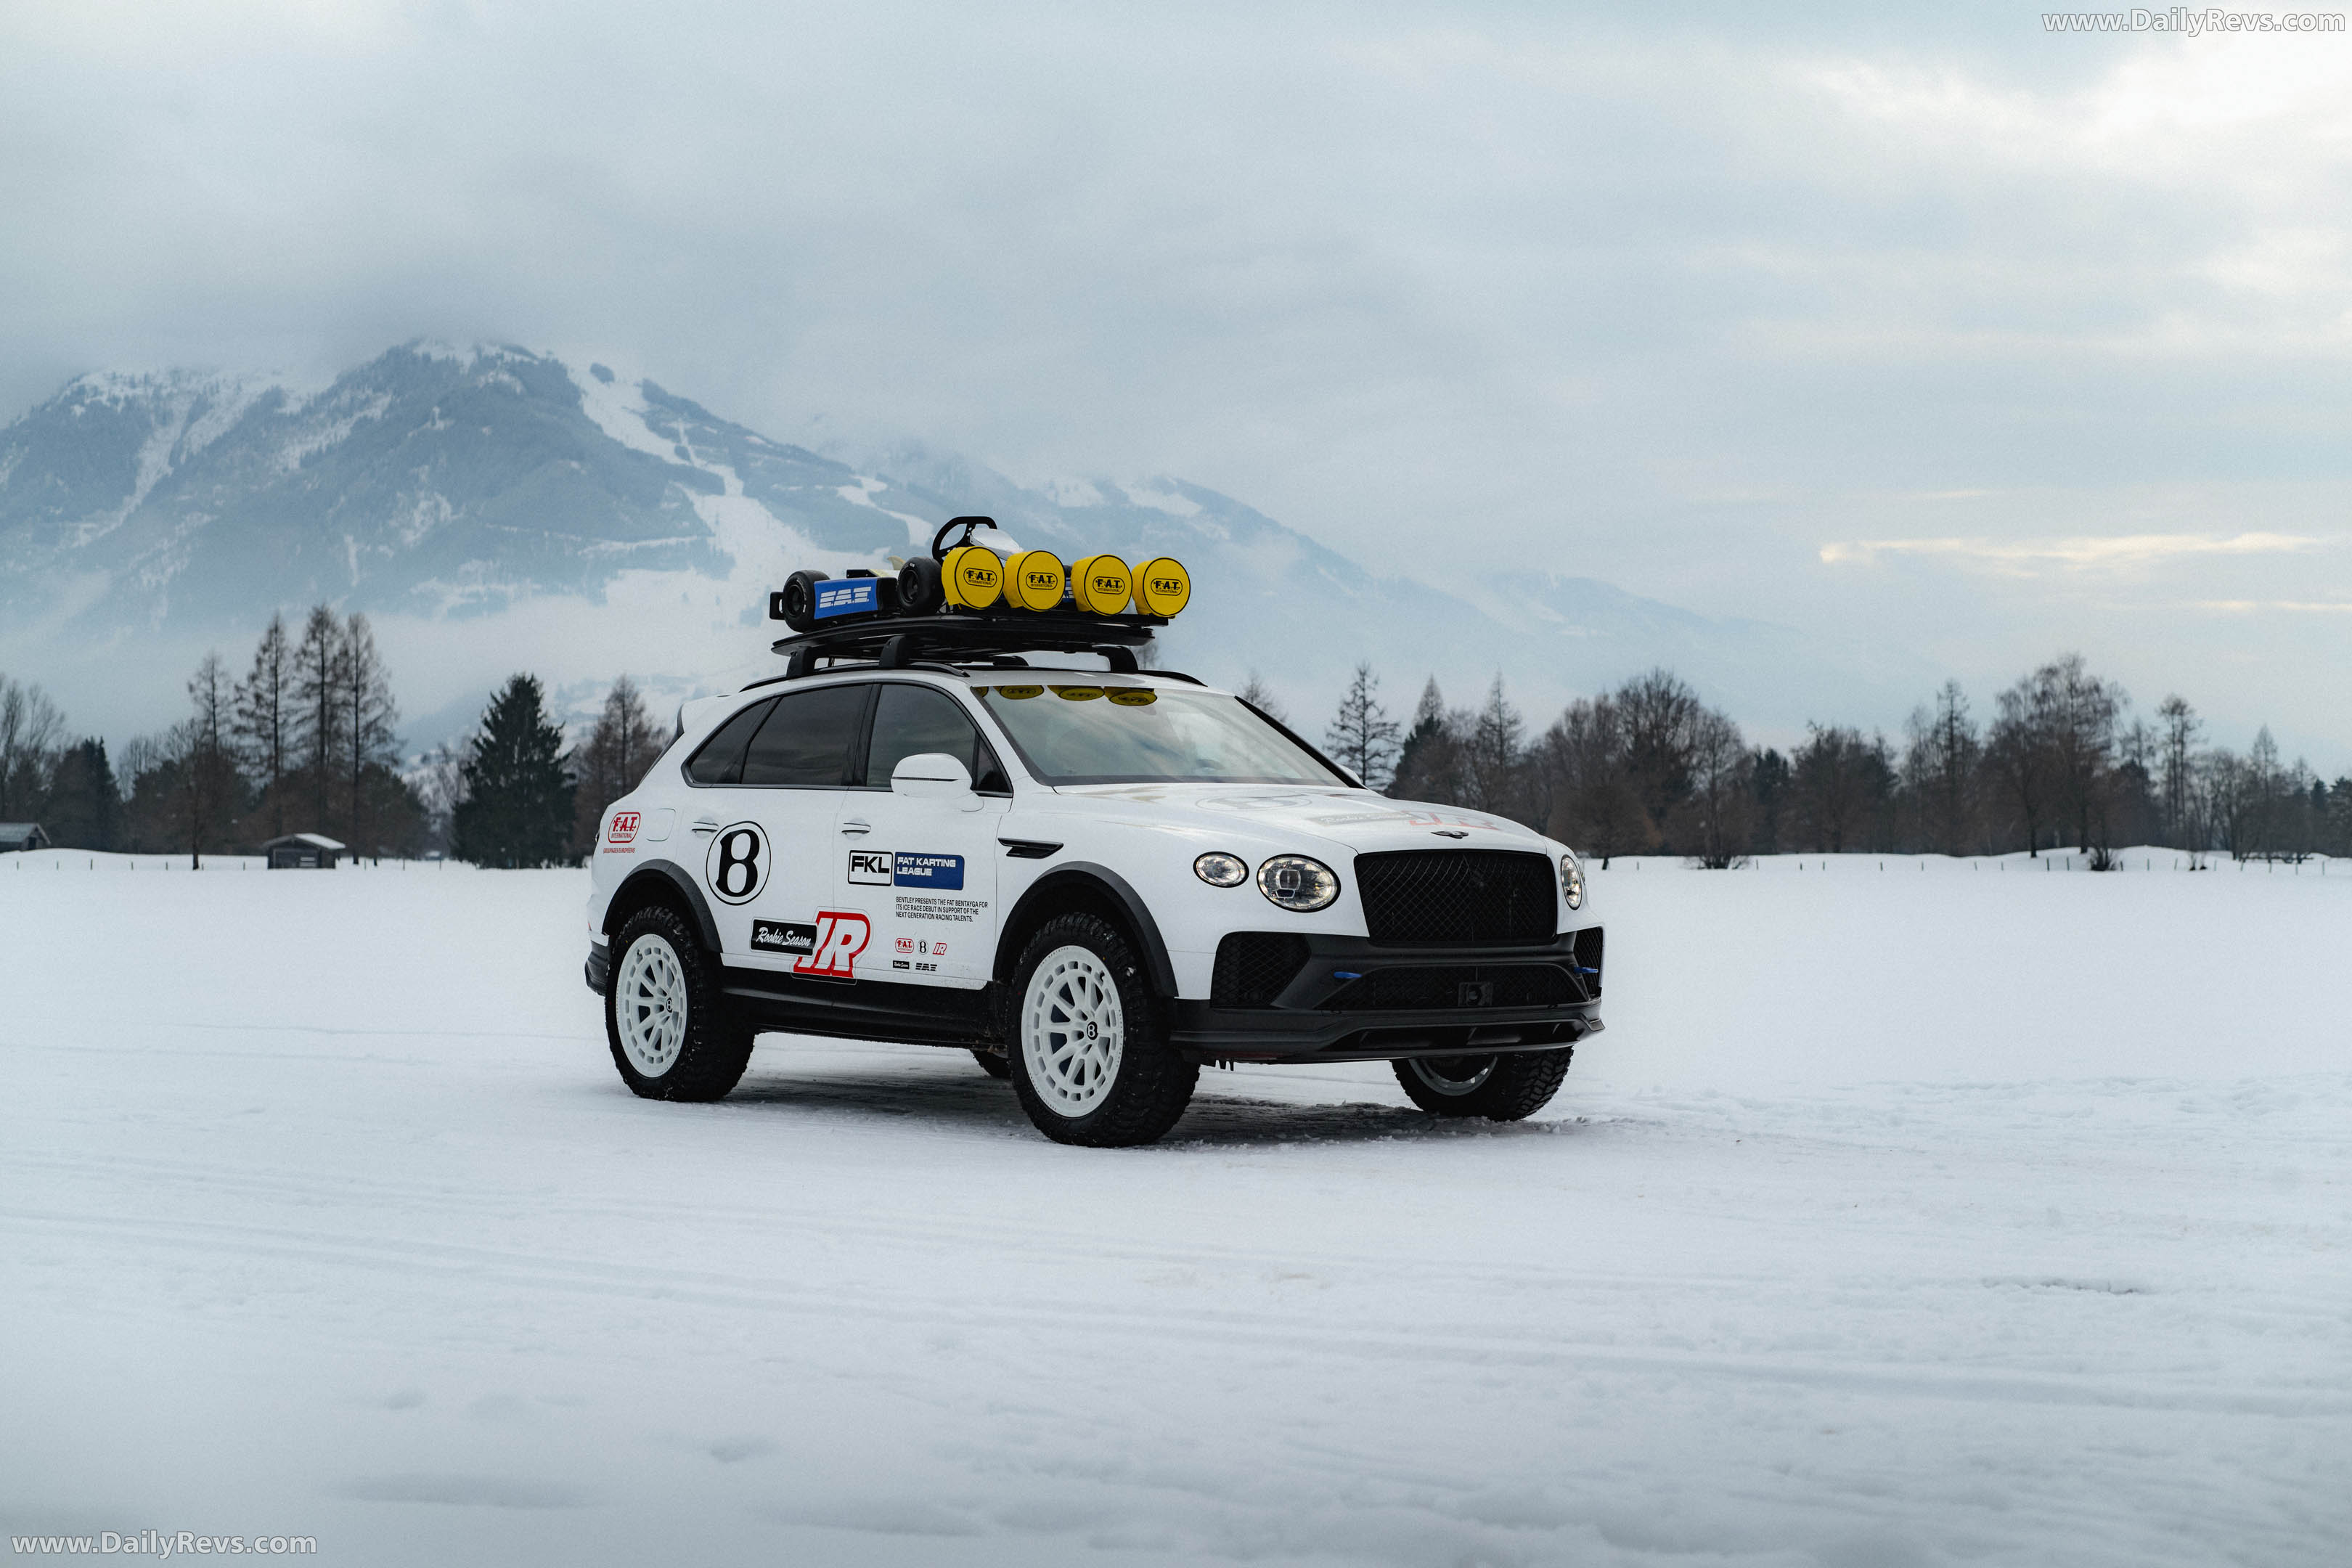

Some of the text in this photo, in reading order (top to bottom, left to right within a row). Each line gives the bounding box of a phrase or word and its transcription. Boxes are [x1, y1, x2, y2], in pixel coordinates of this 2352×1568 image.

[967, 570, 993, 581] F.A.T.
[1030, 575, 1054, 584] F.A.T.
[1097, 579, 1122, 588] F.A.T.
[1155, 581, 1180, 590] F.A.T.
[613, 817, 638, 832] F.A.T.
[851, 855, 890, 874] FKL
[916, 858, 956, 867] KARTING
[897, 867, 932, 876] LEAGUE
[756, 927, 812, 947] Rookie Season
